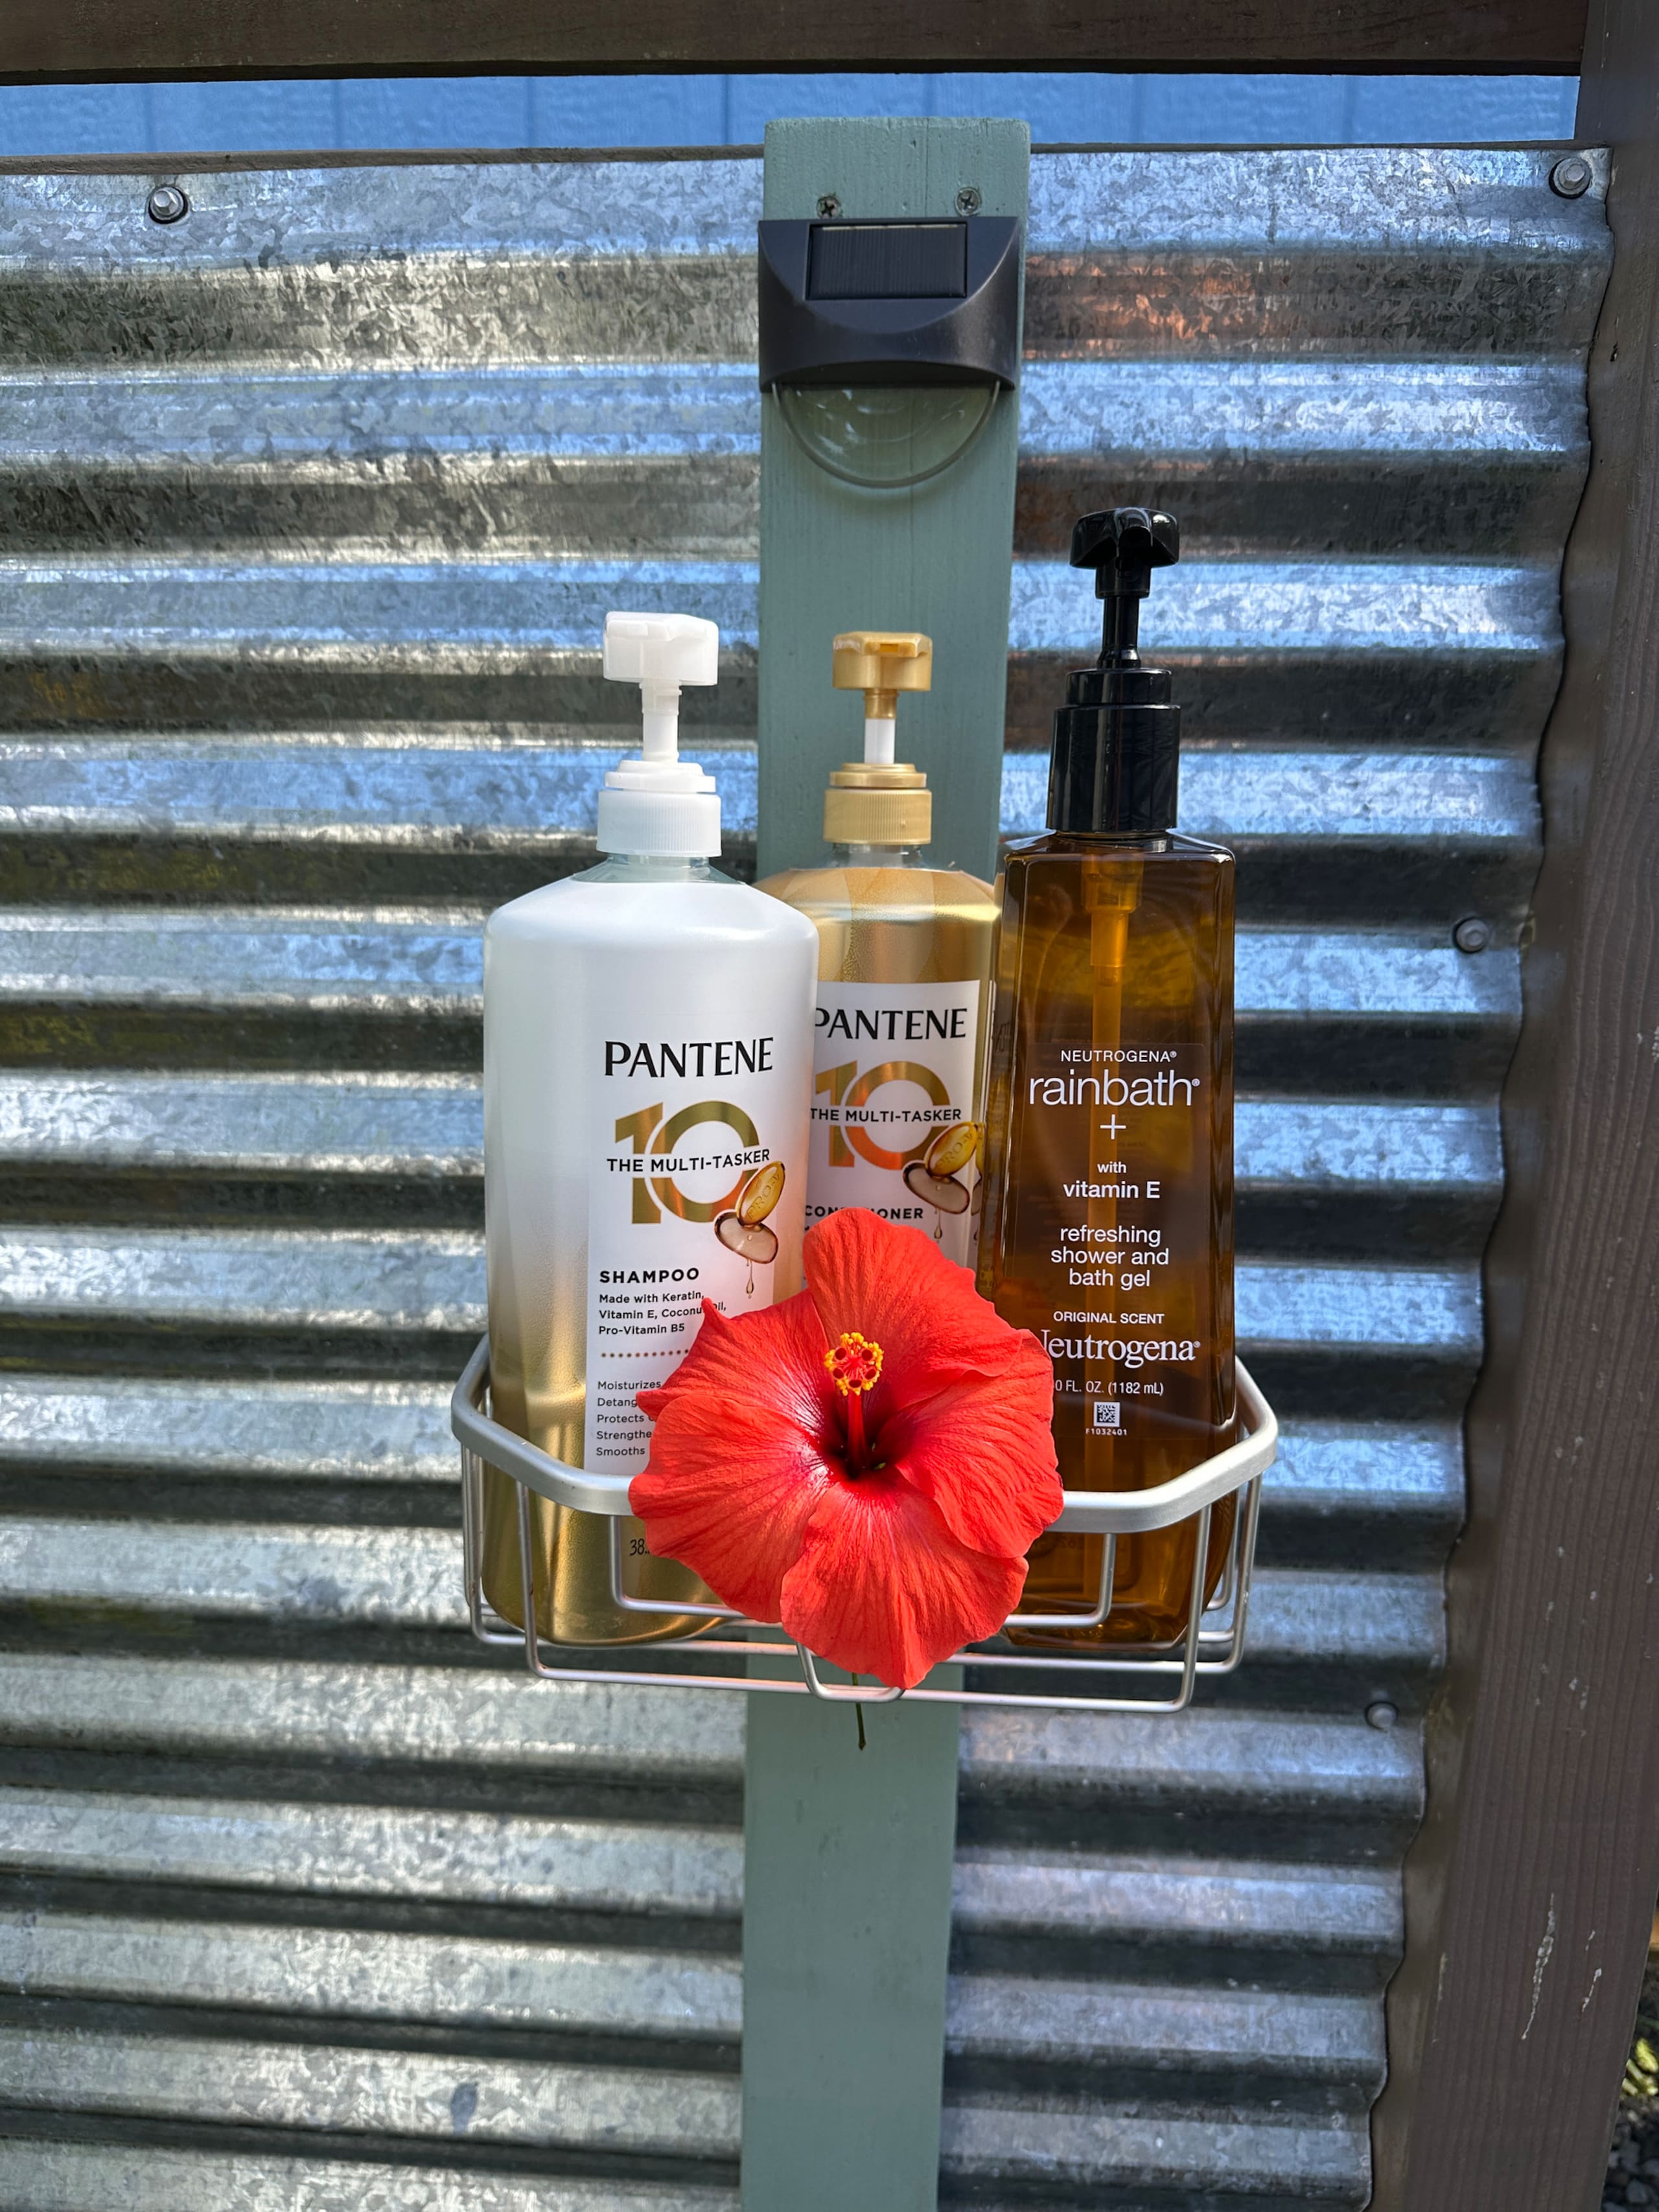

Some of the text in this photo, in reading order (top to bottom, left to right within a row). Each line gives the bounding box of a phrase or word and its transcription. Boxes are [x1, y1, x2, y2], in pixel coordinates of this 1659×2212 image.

[815, 1008, 967, 1040] PANTENE
[604, 1037, 774, 1078] PANTENE
[811, 1108, 962, 1123] THE MULTI-TASKER
[815, 1060, 950, 1170] 10
[607, 1149, 770, 1172] THE MULTI-TASKER
[615, 1100, 760, 1224] 10
[1097, 1161, 1126, 1173] with
[1063, 1180, 1161, 1199] vitamin E
[1060, 1225, 1161, 1248] refreshing
[1050, 1246, 1169, 1265] shower and
[599, 1268, 699, 1284] SHAMPOO
[1069, 1268, 1150, 1291] bath gel
[599, 1291, 704, 1303] Made with Keratin,
[599, 1310, 644, 1319] Vitamin
[648, 1310, 657, 1320] E,
[662, 1306, 702, 1318] Coconu
[1053, 1311, 1165, 1325] ORIGINAL SCENT
[599, 1323, 685, 1335] Pro-Vitamin B5
[597, 1381, 661, 1390] Moisturizes
[1055, 1379, 1164, 1396] 0 FL. OZ. (1182 mL)
[597, 1398, 638, 1408] Detang
[597, 1414, 644, 1423] Protects
[596, 1430, 652, 1441] Strengthe
[596, 1447, 645, 1456] Smooths
[629, 1538, 650, 1555] 38.
